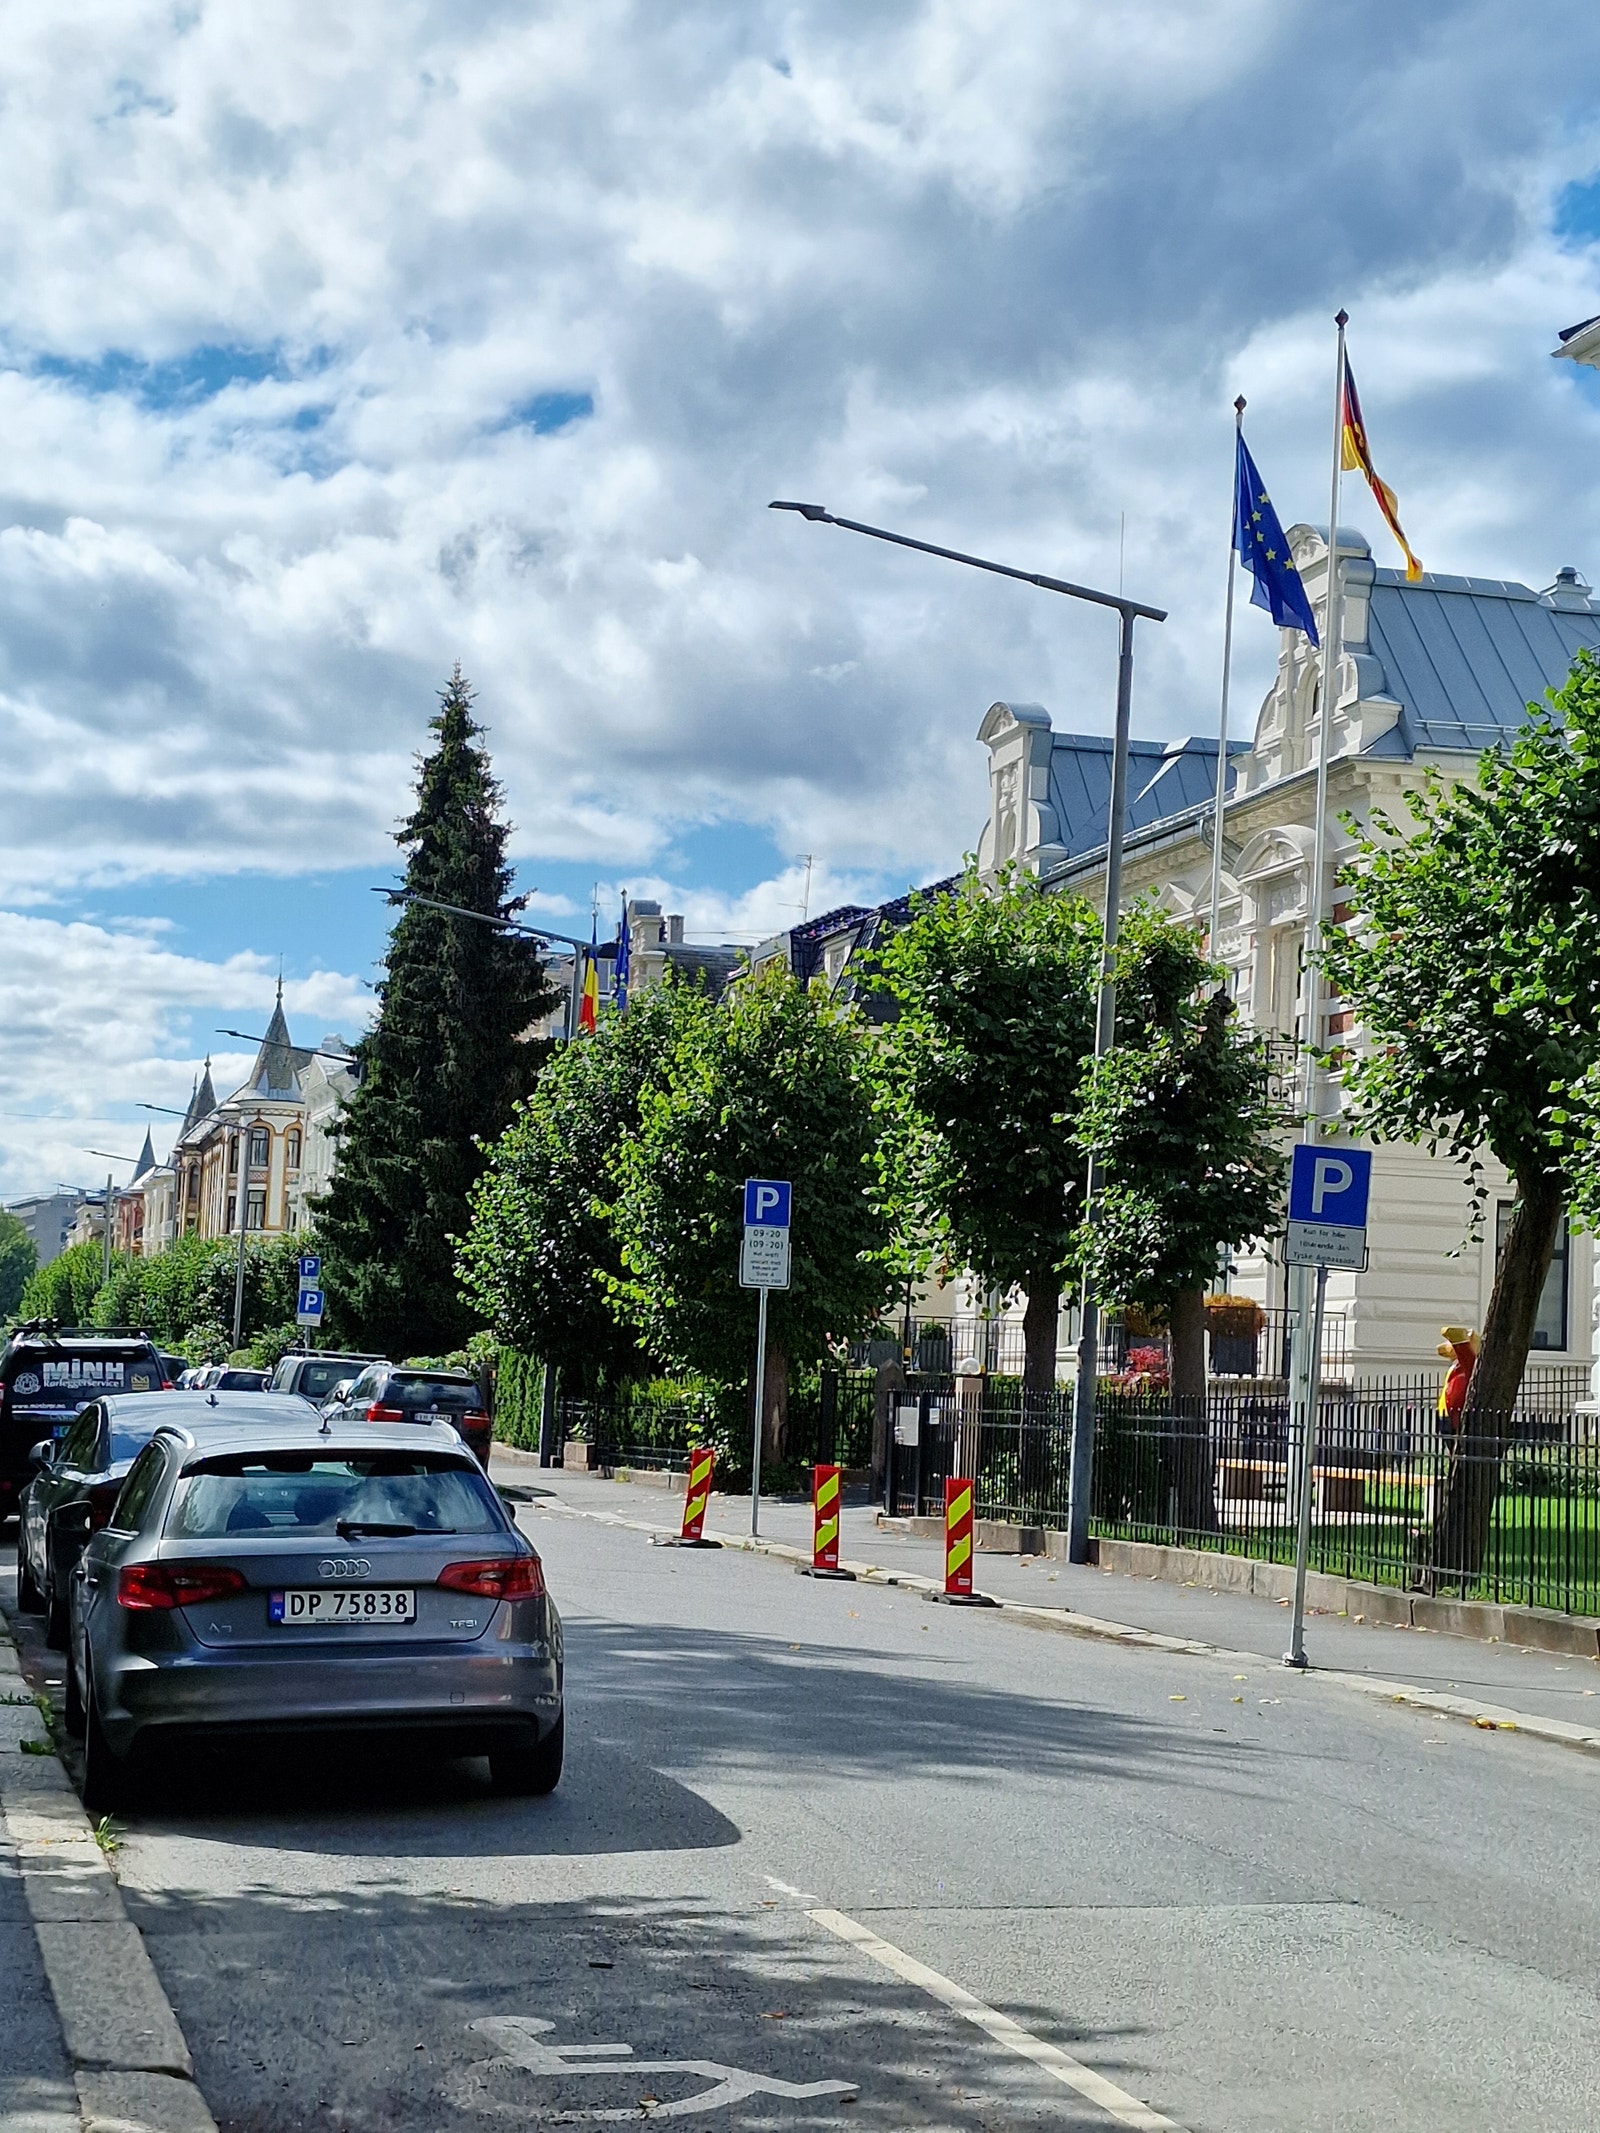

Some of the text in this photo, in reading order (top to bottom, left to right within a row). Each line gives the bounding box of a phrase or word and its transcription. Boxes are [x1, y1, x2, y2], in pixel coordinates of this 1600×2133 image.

[1312, 1157, 1353, 1214] P
[756, 1186, 780, 1220] P
[305, 1260, 315, 1274] P
[305, 1293, 317, 1311] P
[290, 1592, 408, 1616] DP 75838
